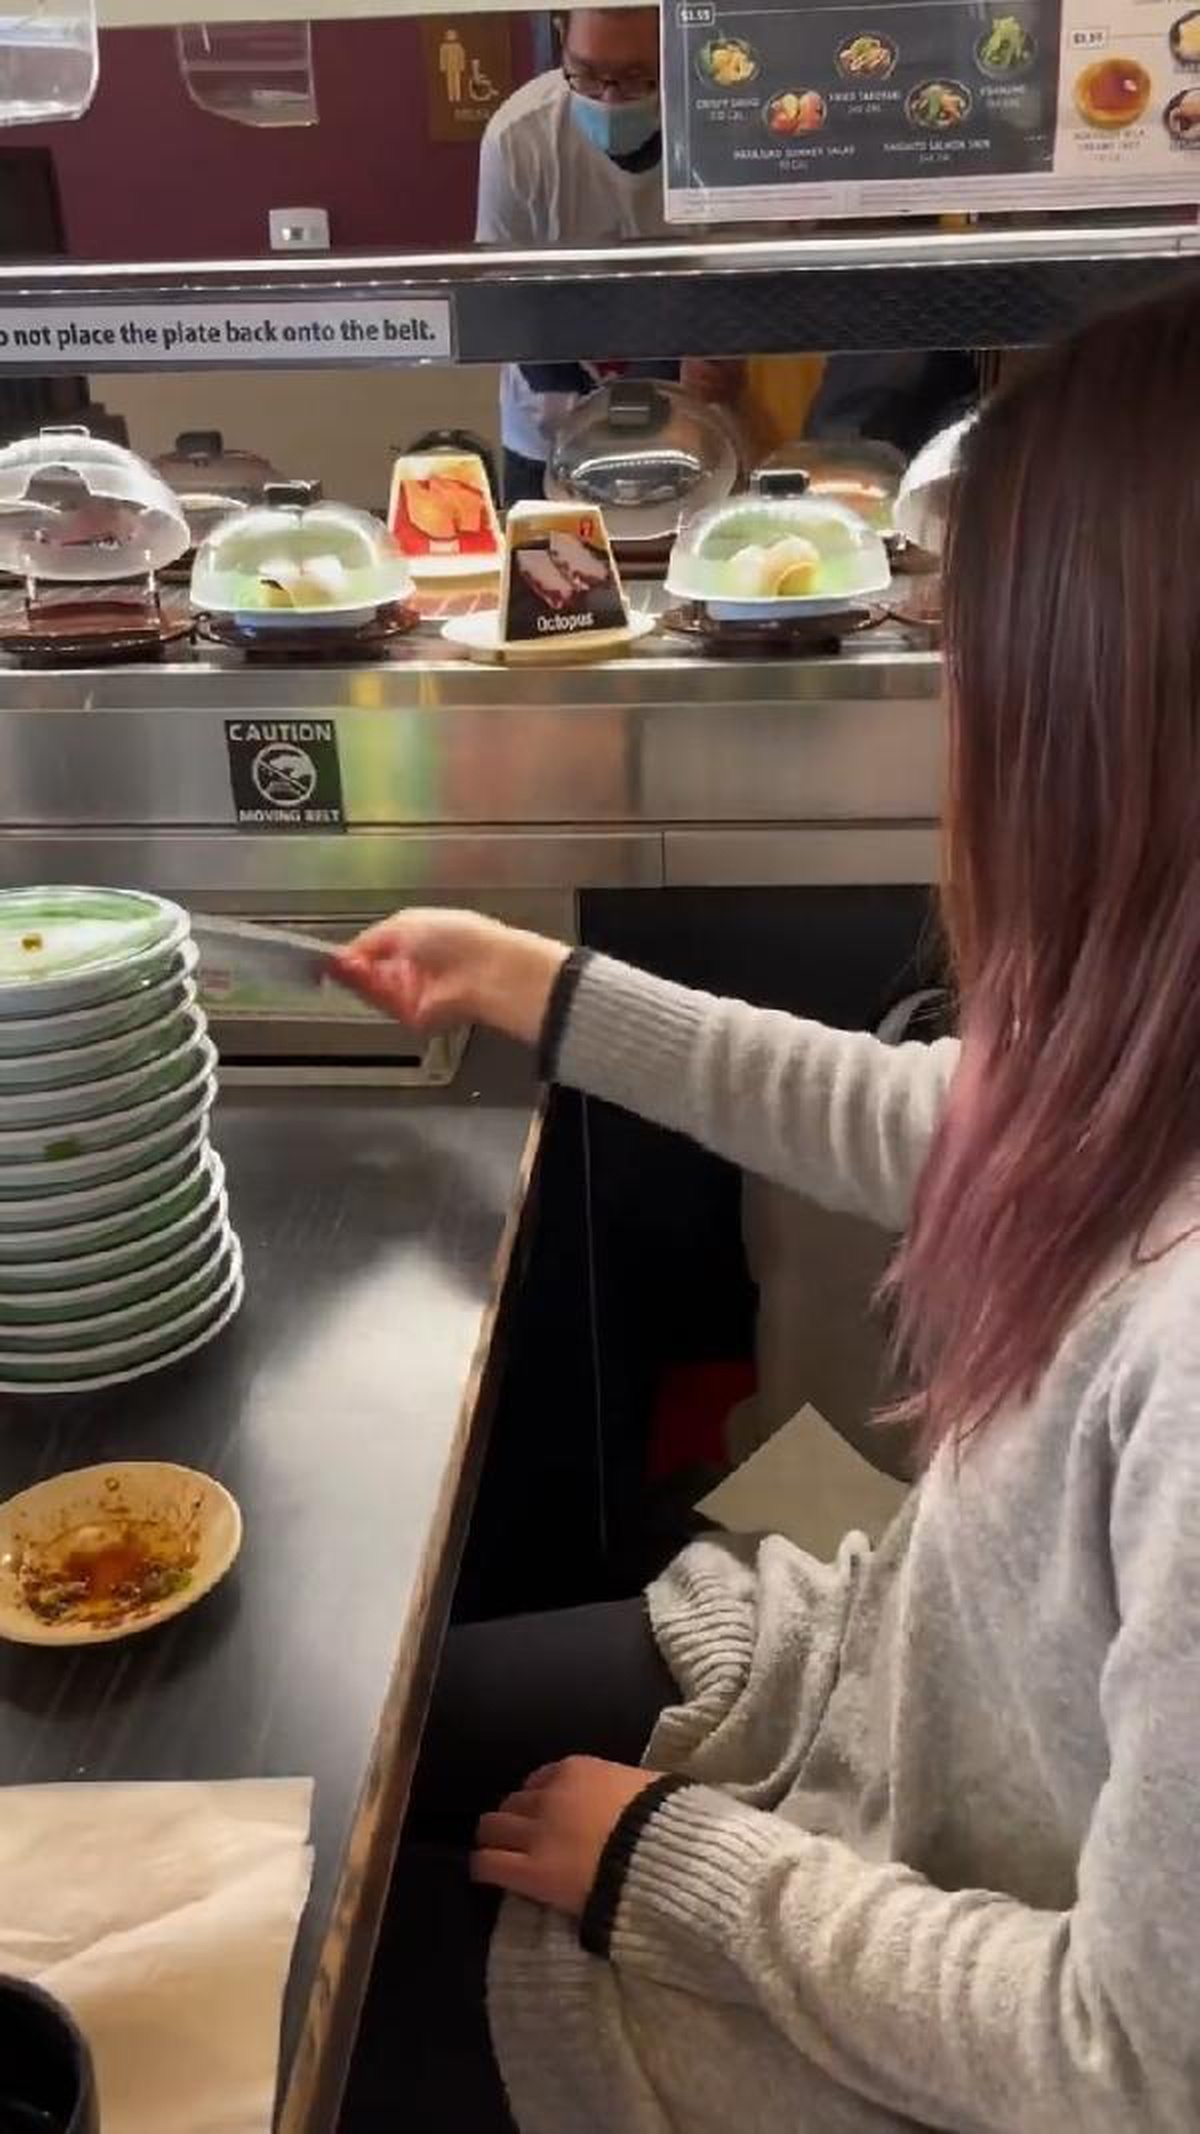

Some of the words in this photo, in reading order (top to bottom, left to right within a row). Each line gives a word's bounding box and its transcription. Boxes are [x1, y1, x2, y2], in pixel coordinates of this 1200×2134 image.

[13, 326, 52, 346] not
[57, 322, 115, 351] place
[120, 321, 157, 344] the
[162, 320, 221, 350] plate
[226, 319, 277, 342] back
[282, 321, 335, 342] onto
[340, 319, 379, 341] the
[383, 318, 436, 341] belt.
[536, 612, 595, 632] Octopus
[228, 723, 332, 741] CAUTION
[239, 809, 301, 822] MOVING
[304, 809, 340, 822] BELT
